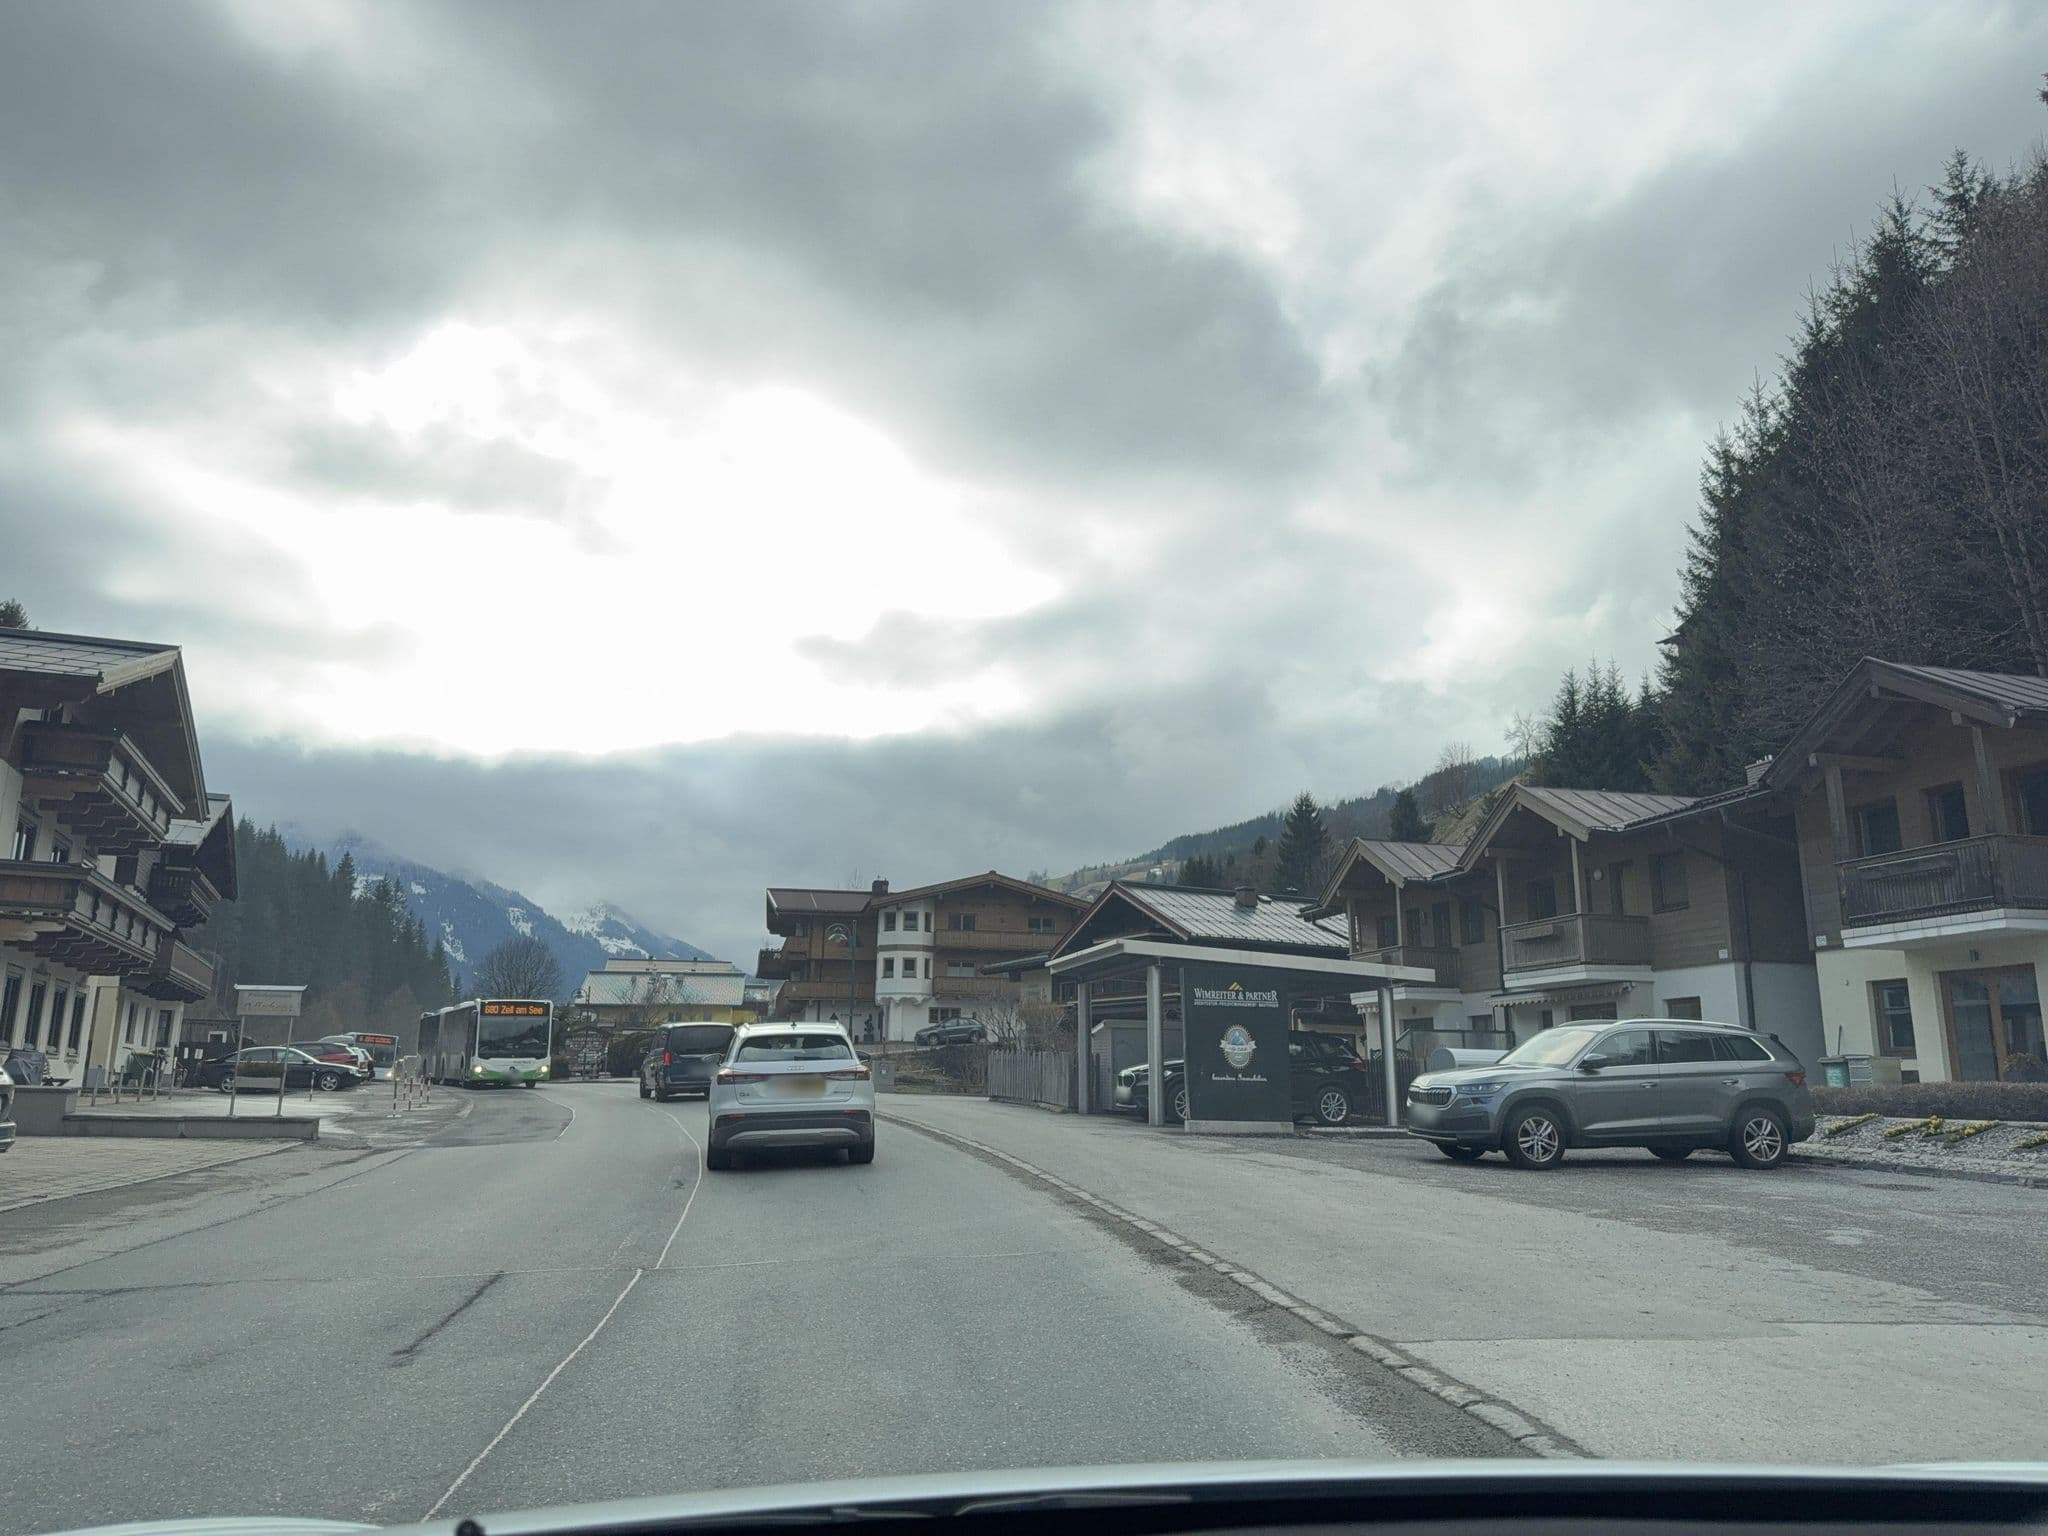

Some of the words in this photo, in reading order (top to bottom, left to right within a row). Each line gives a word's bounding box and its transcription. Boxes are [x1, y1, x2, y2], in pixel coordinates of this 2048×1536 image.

[1238, 990, 1244, 1000] &
[1246, 990, 1278, 1001] PARTNER
[484, 1005, 499, 1014] 680
[500, 1005, 514, 1014] Zell
[528, 1005, 544, 1015] See
